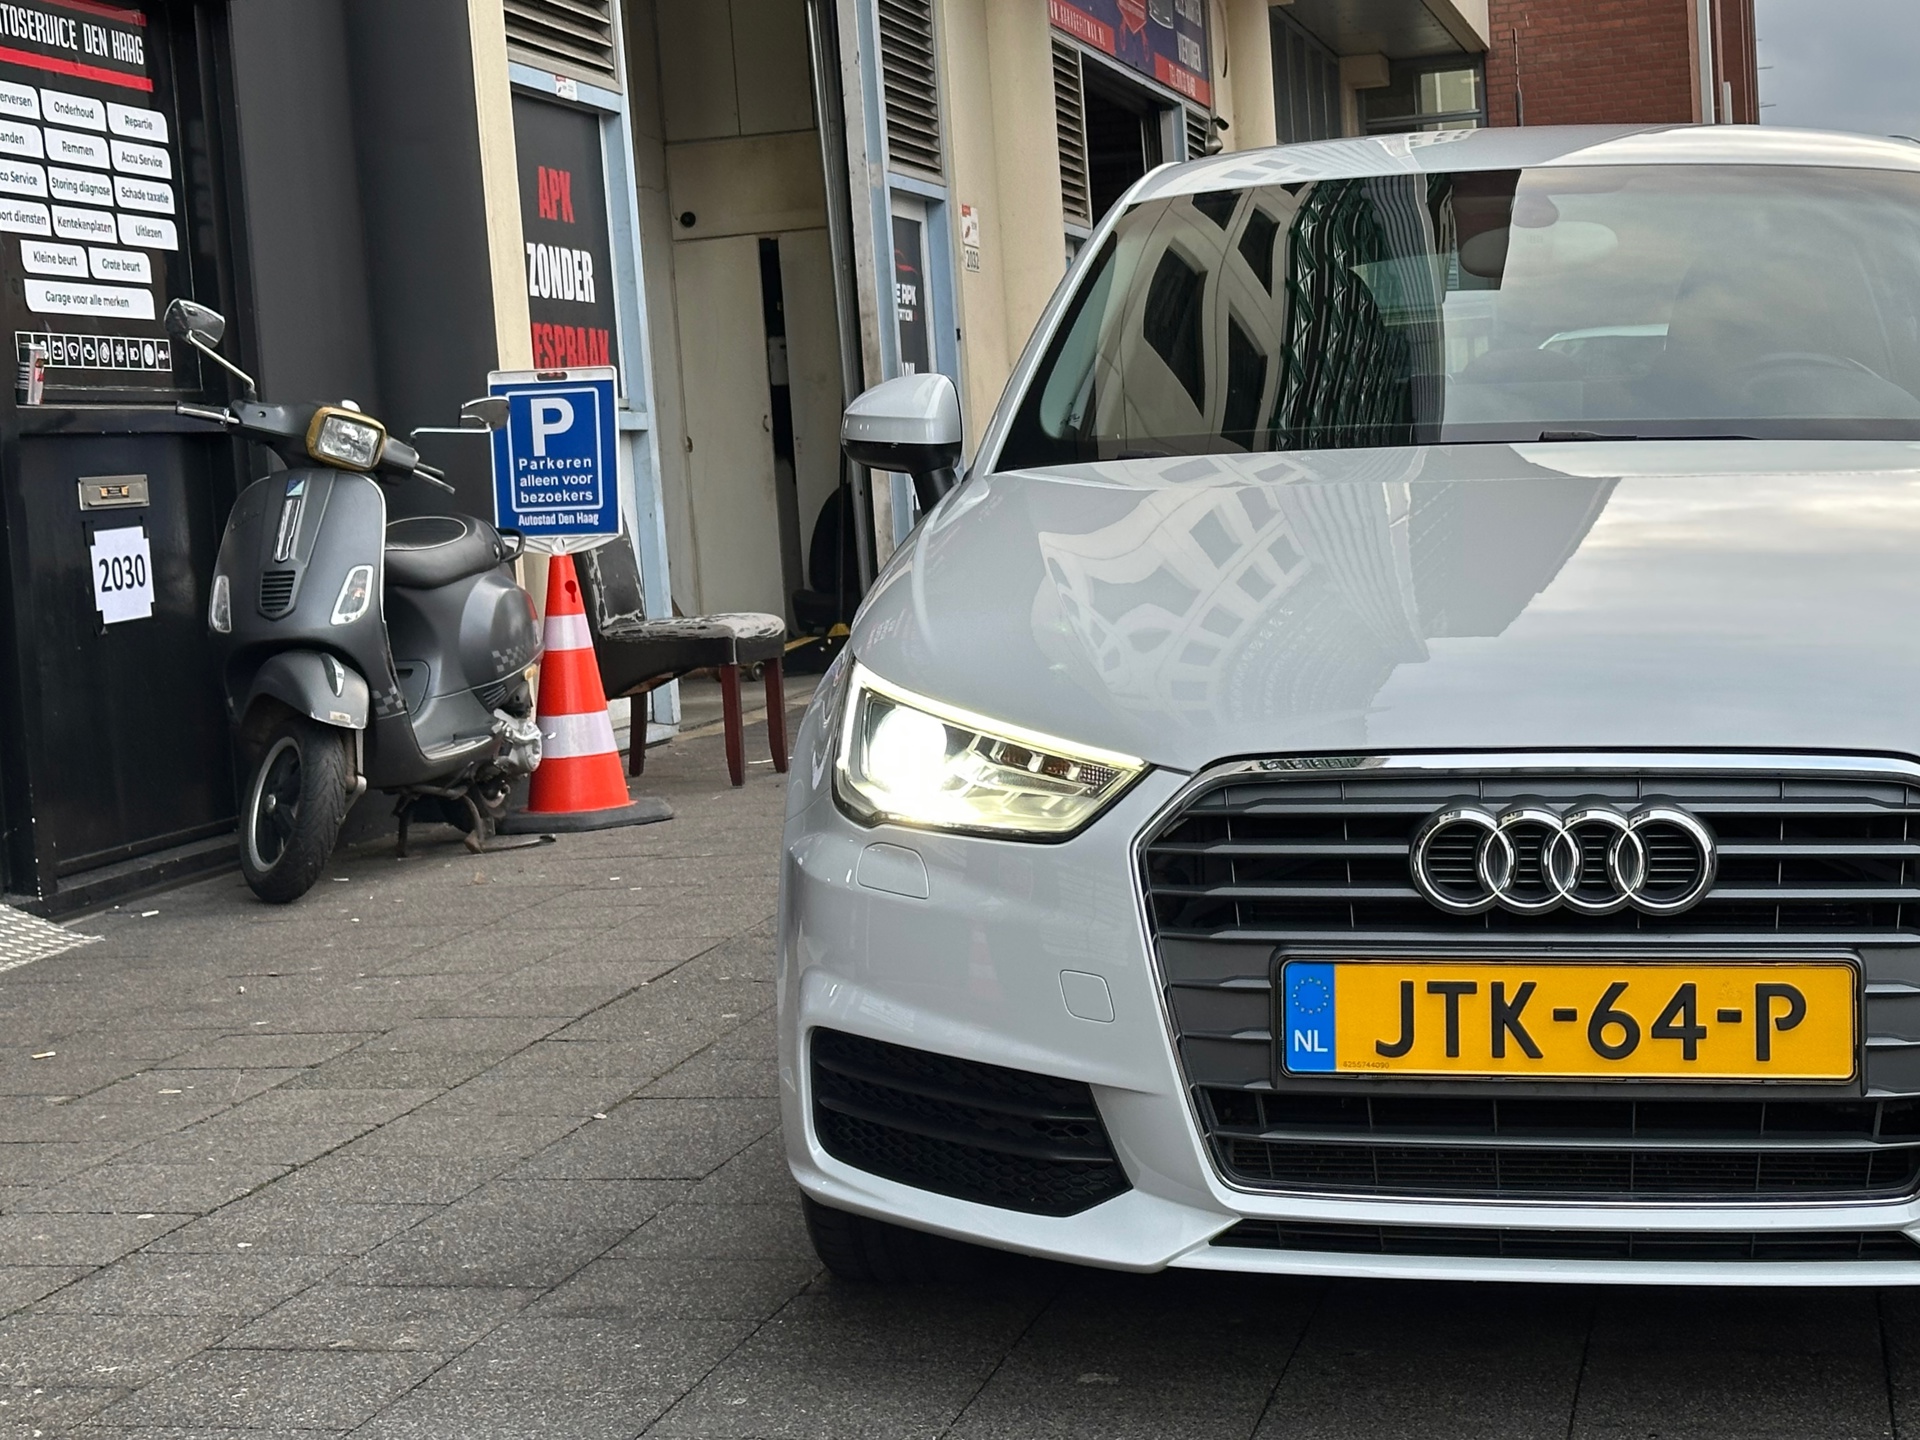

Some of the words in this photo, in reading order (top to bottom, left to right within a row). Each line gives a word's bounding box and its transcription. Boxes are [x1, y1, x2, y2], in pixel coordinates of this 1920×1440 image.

[0, 3, 78, 51] TOSERVICE
[83, 23, 108, 57] DEN
[111, 29, 144, 65] HAAG
[54, 101, 94, 119] Onderhoud
[62, 141, 94, 157] Remmen
[121, 151, 137, 164] Accu
[139, 154, 163, 168] Service
[10, 171, 38, 186] Service
[51, 177, 78, 194] Storing
[79, 181, 110, 197] diagnose
[121, 187, 145, 201] Schade
[146, 191, 169, 204] taxatie
[537, 165, 575, 224] APK
[14, 210, 46, 226] diensten
[57, 216, 113, 234] Kentekenplaten
[135, 225, 163, 239] Uitlezen
[33, 251, 56, 264] Kleine
[58, 252, 78, 267] beurt
[102, 258, 121, 271] Grote
[122, 259, 141, 272] beurt
[526, 242, 595, 303] ZONDER
[45, 290, 71, 306] Garage
[72, 295, 88, 306] voor
[89, 293, 102, 306] alle
[103, 296, 130, 308] merken
[530, 397, 575, 457] P
[519, 457, 592, 471] Parkeren
[519, 474, 559, 488] alleen
[562, 473, 593, 485] voor
[520, 489, 593, 504] bezoekers
[518, 513, 556, 527] Autostad
[558, 513, 575, 525] Den
[576, 512, 599, 526] Haag
[99, 554, 146, 593] 2030
[1375, 980, 1808, 1061] JTK-64-P
[1293, 1030, 1328, 1054] NL
